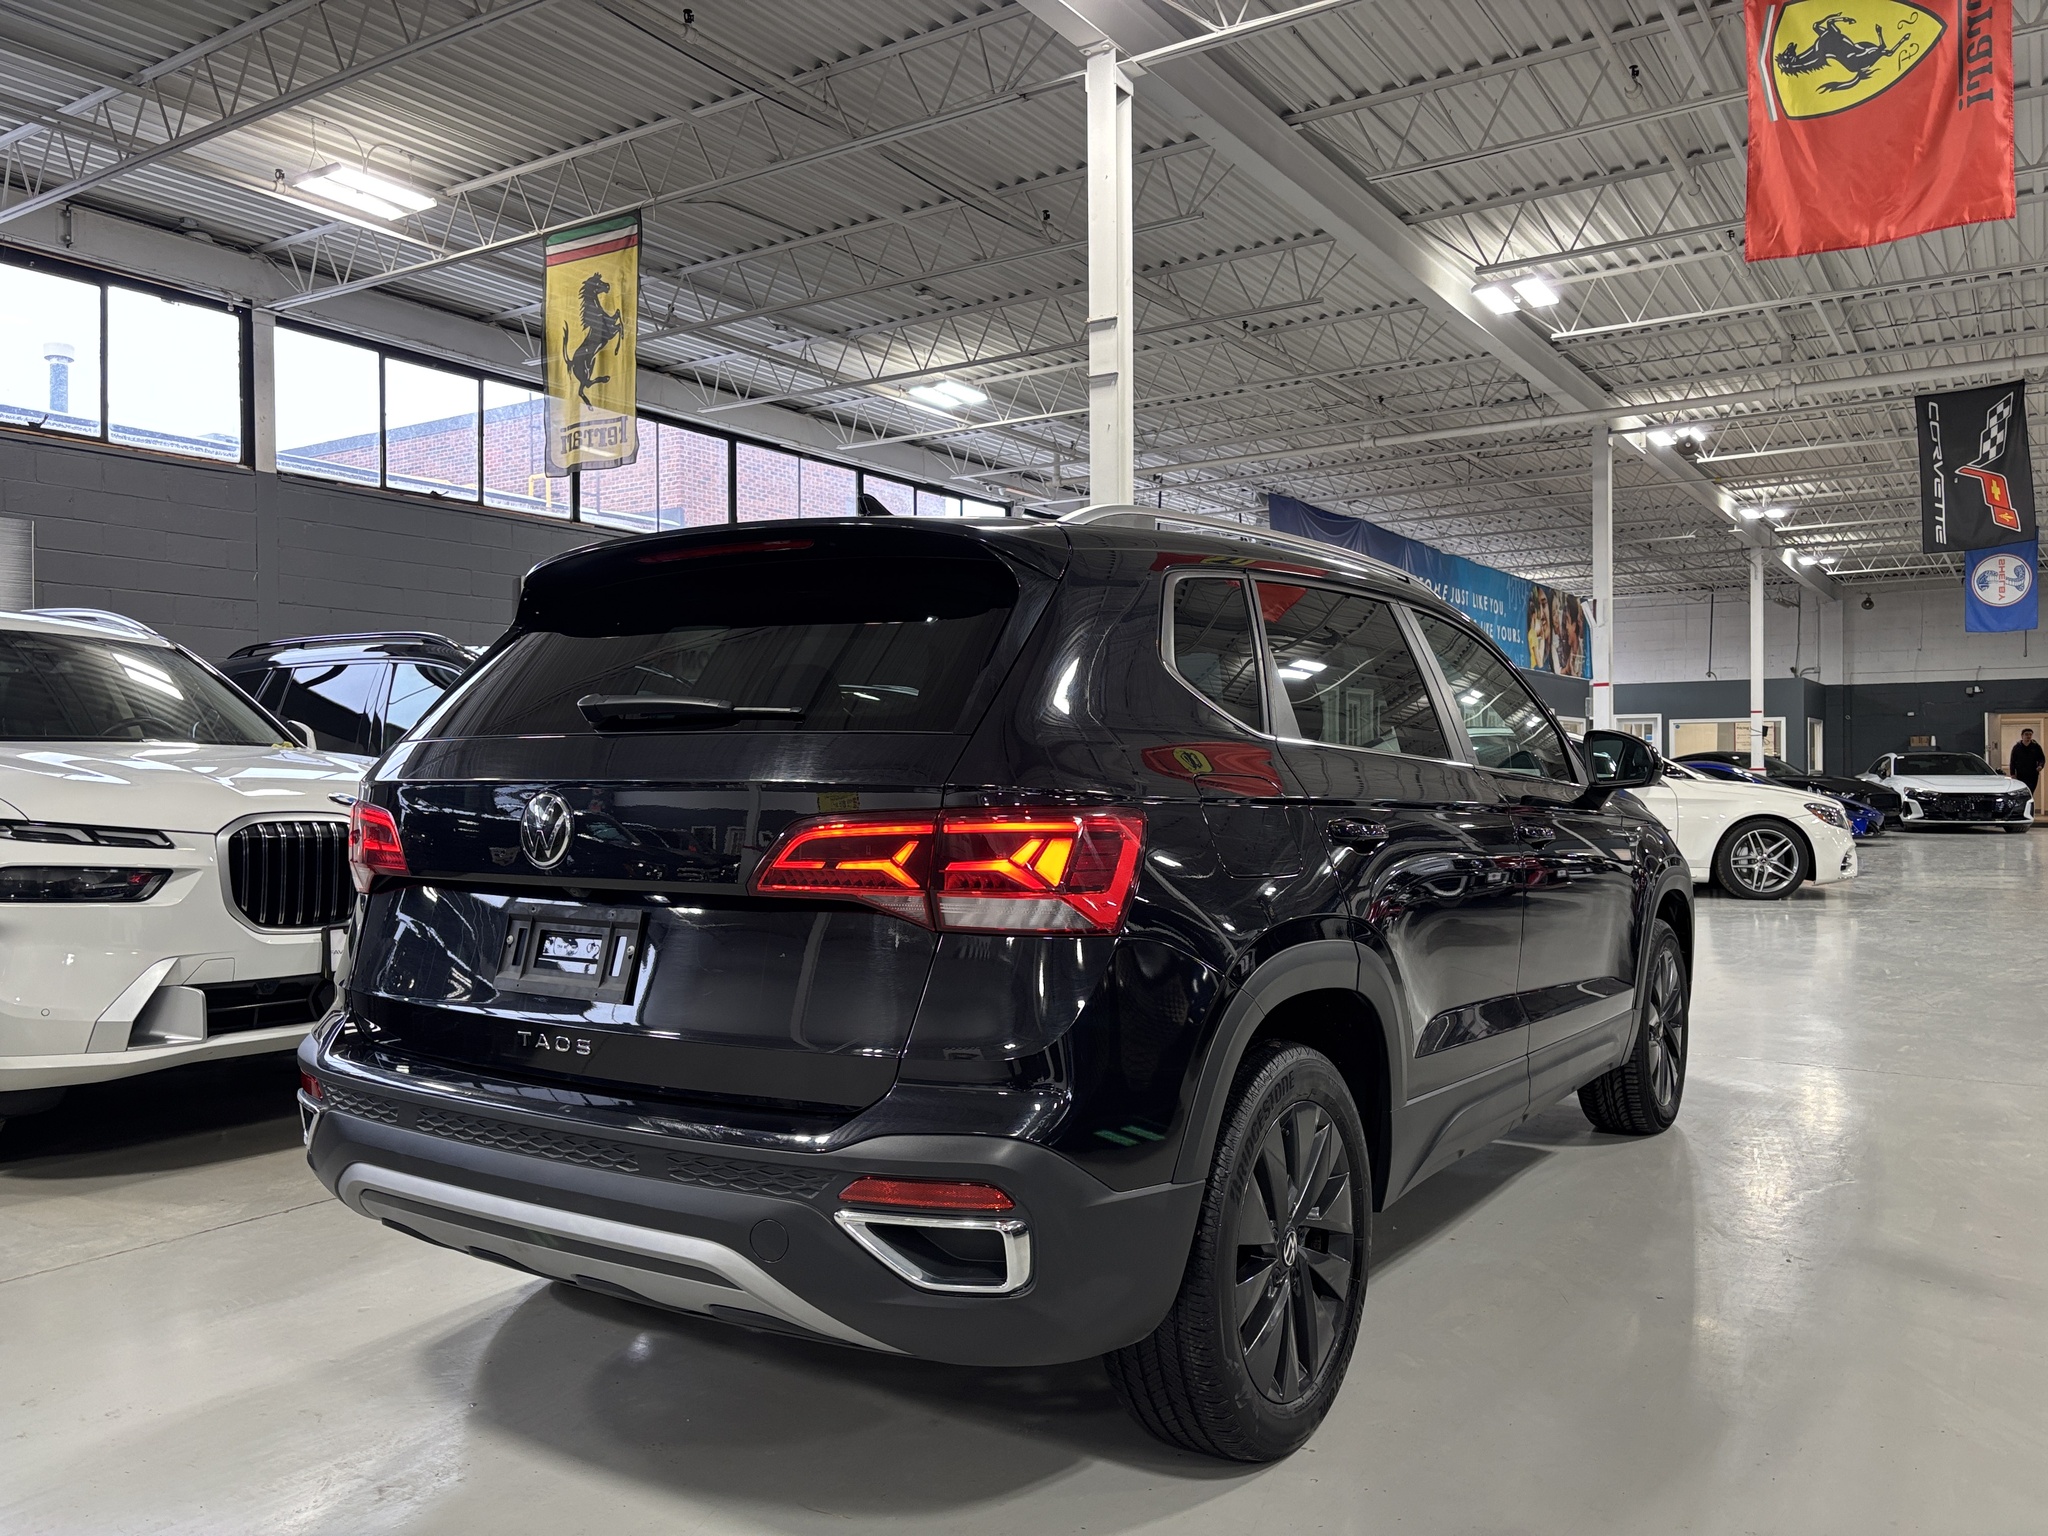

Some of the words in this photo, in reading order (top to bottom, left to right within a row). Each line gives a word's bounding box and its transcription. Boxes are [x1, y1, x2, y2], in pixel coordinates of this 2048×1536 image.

[1928, 400, 1947, 545] CORVETTE
[1450, 586, 1469, 607] JUST
[1472, 592, 1488, 611] LIKE
[1496, 624, 1524, 644] YOURS.
[517, 1030, 591, 1055] TAOS
[1229, 1070, 1295, 1206] BRIDGESTONE
